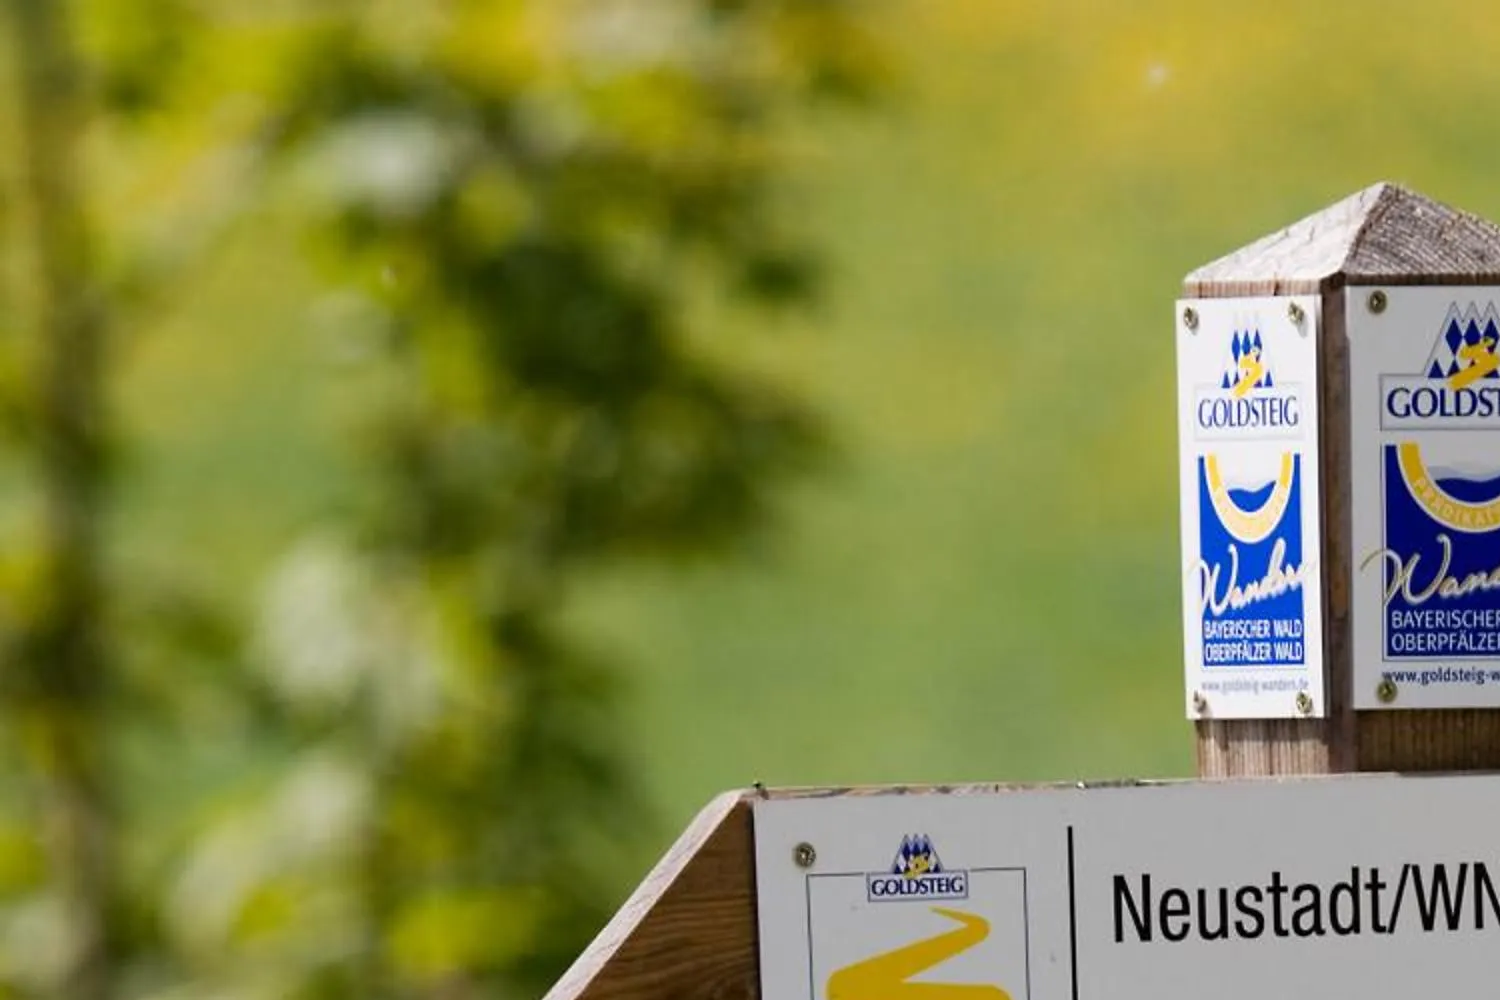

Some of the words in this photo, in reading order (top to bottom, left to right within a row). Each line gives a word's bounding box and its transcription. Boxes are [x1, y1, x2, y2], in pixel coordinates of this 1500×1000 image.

[1198, 396, 1299, 429] GOLDSTEIG
[1204, 619, 1271, 639] BAYERISCHER
[1274, 619, 1303, 638] WALD
[1274, 642, 1303, 661] WALD
[871, 876, 964, 897] GOLDSTEIG
